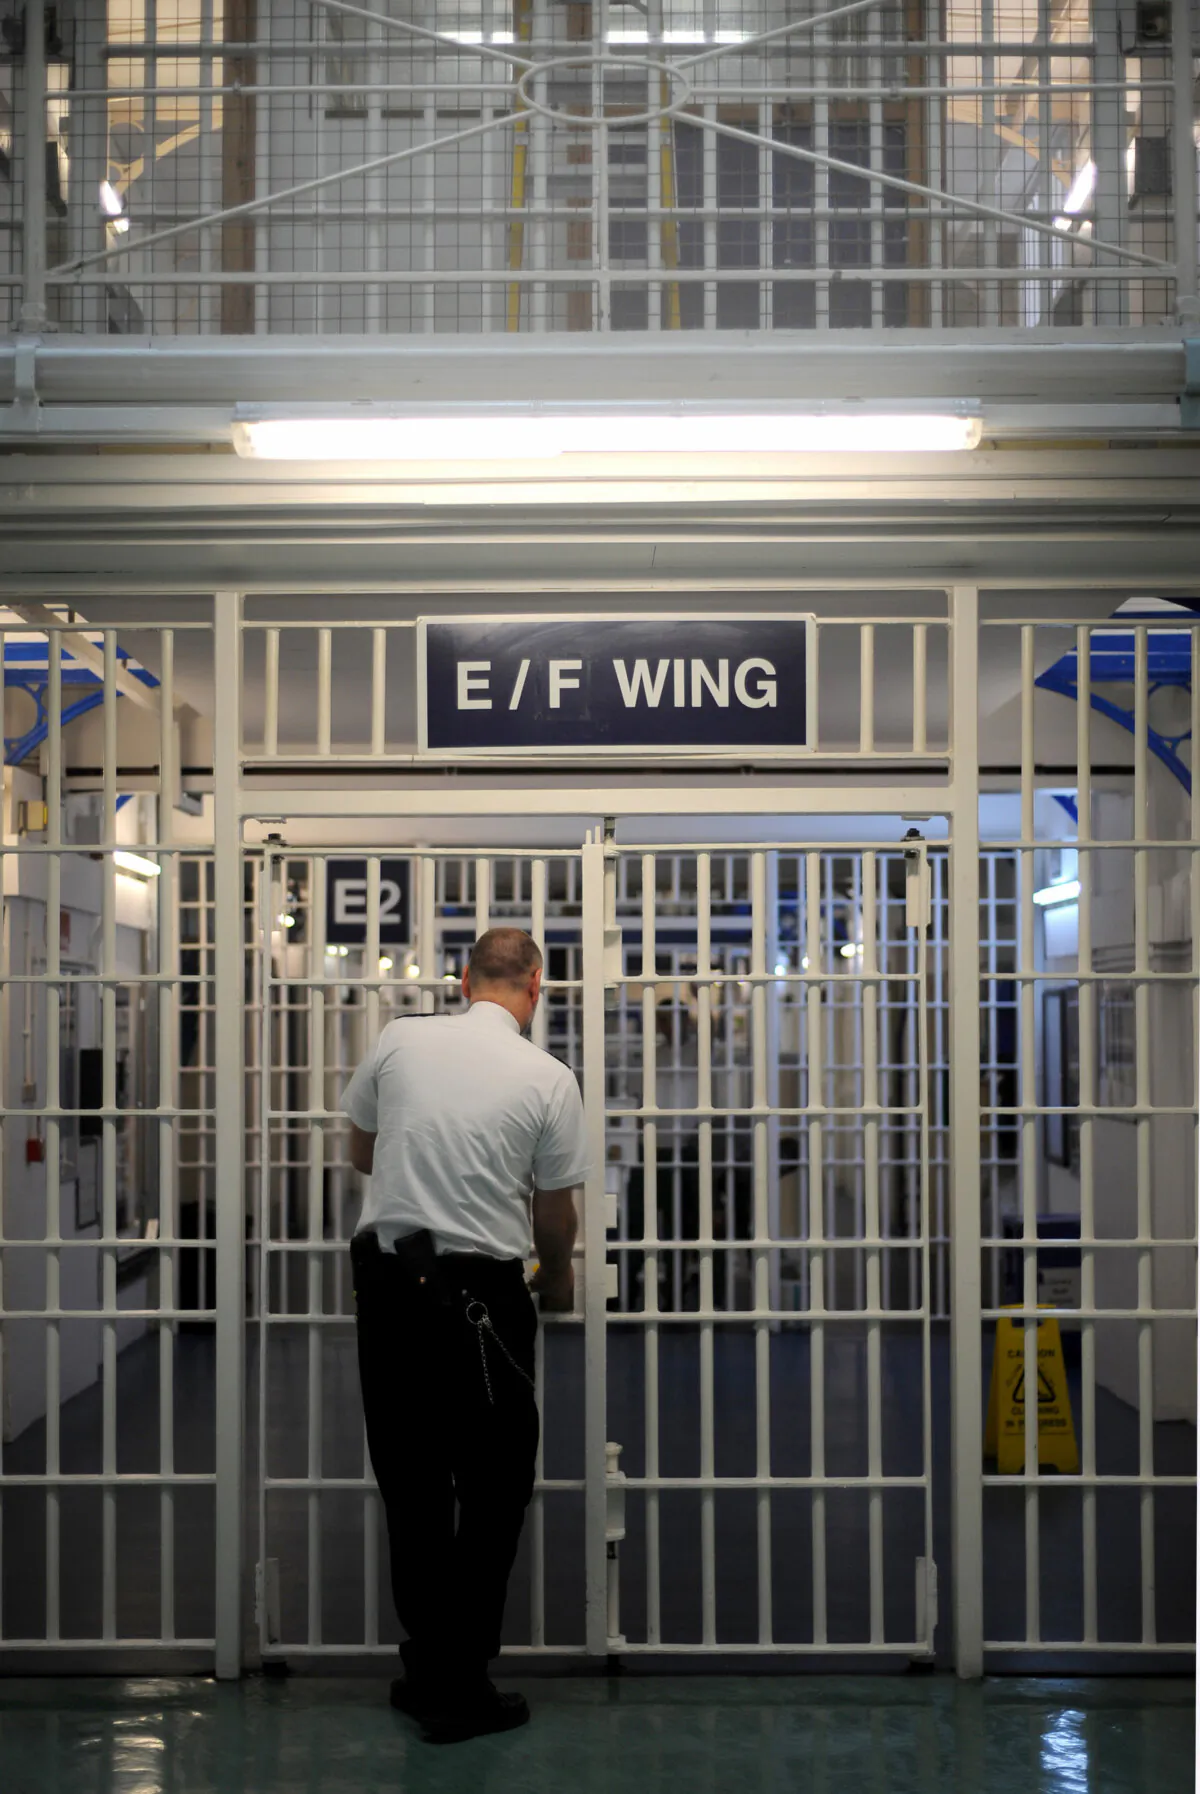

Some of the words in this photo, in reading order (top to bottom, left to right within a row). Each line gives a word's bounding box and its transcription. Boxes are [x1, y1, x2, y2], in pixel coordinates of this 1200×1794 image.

[457, 661, 492, 710] E
[548, 660, 583, 709] F
[613, 658, 778, 708] WING
[334, 878, 401, 924] E2
[1007, 1349, 1056, 1358] CAION
